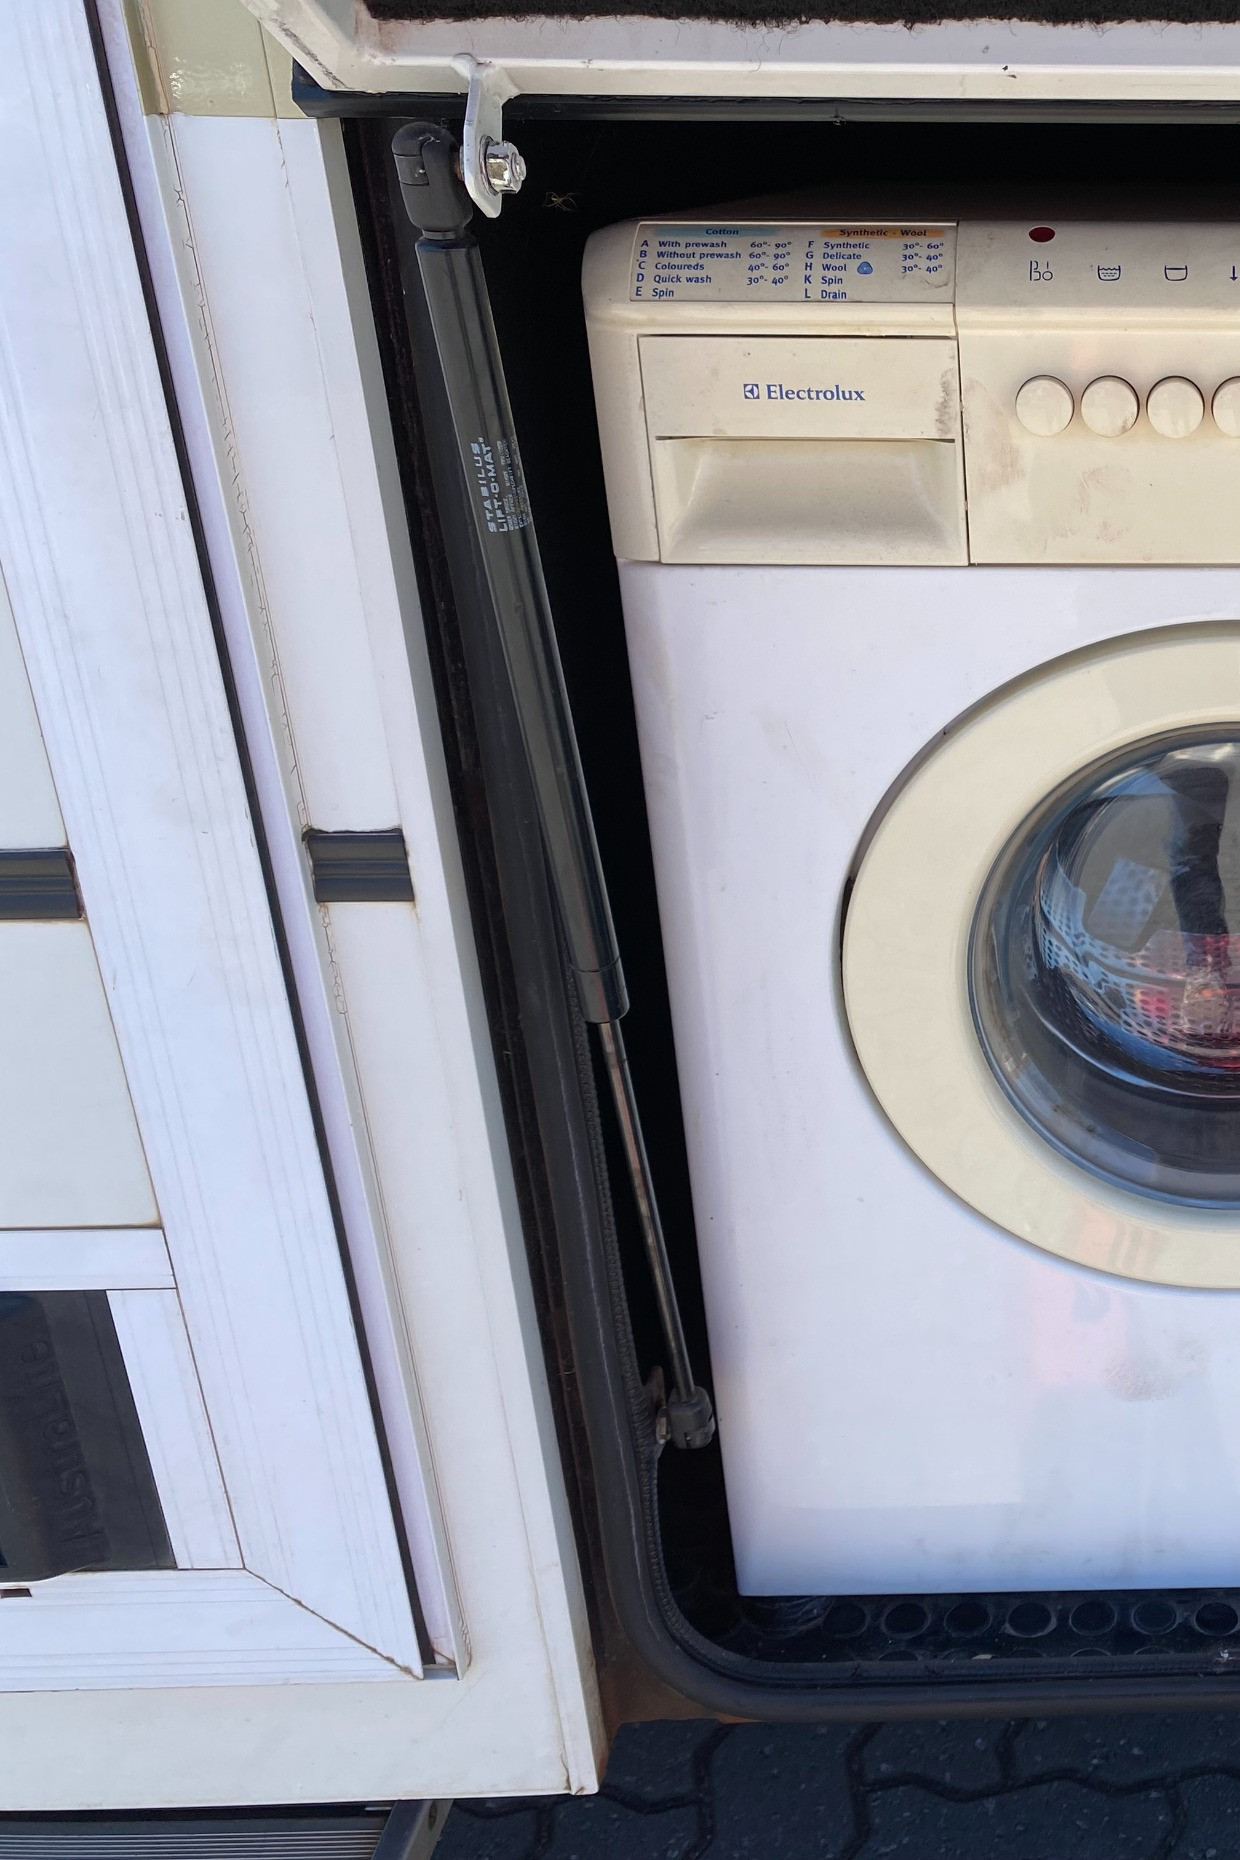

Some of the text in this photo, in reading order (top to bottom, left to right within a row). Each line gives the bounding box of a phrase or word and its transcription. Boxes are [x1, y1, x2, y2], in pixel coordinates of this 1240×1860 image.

[839, 229, 888, 237] Synthetic
[658, 240, 680, 248] With
[685, 241, 727, 249] prewash
[824, 242, 870, 250] Synthetic
[639, 250, 647, 258] B
[657, 250, 696, 258] Without
[700, 251, 741, 260] prewash
[806, 251, 813, 259] G
[823, 252, 862, 260] Delicate
[638, 261, 646, 269] C
[655, 262, 705, 270] Coloureds
[805, 263, 812, 271] H
[822, 263, 847, 271] Wool
[636, 273, 644, 282] D
[654, 274, 681, 284] Quick
[686, 274, 712, 283] wash
[804, 275, 843, 286] K Spin
[635, 287, 674, 299] E Spin
[805, 288, 847, 299] L Drain
[766, 384, 865, 400] Electrolux
[471, 443, 498, 532] STABILUS
